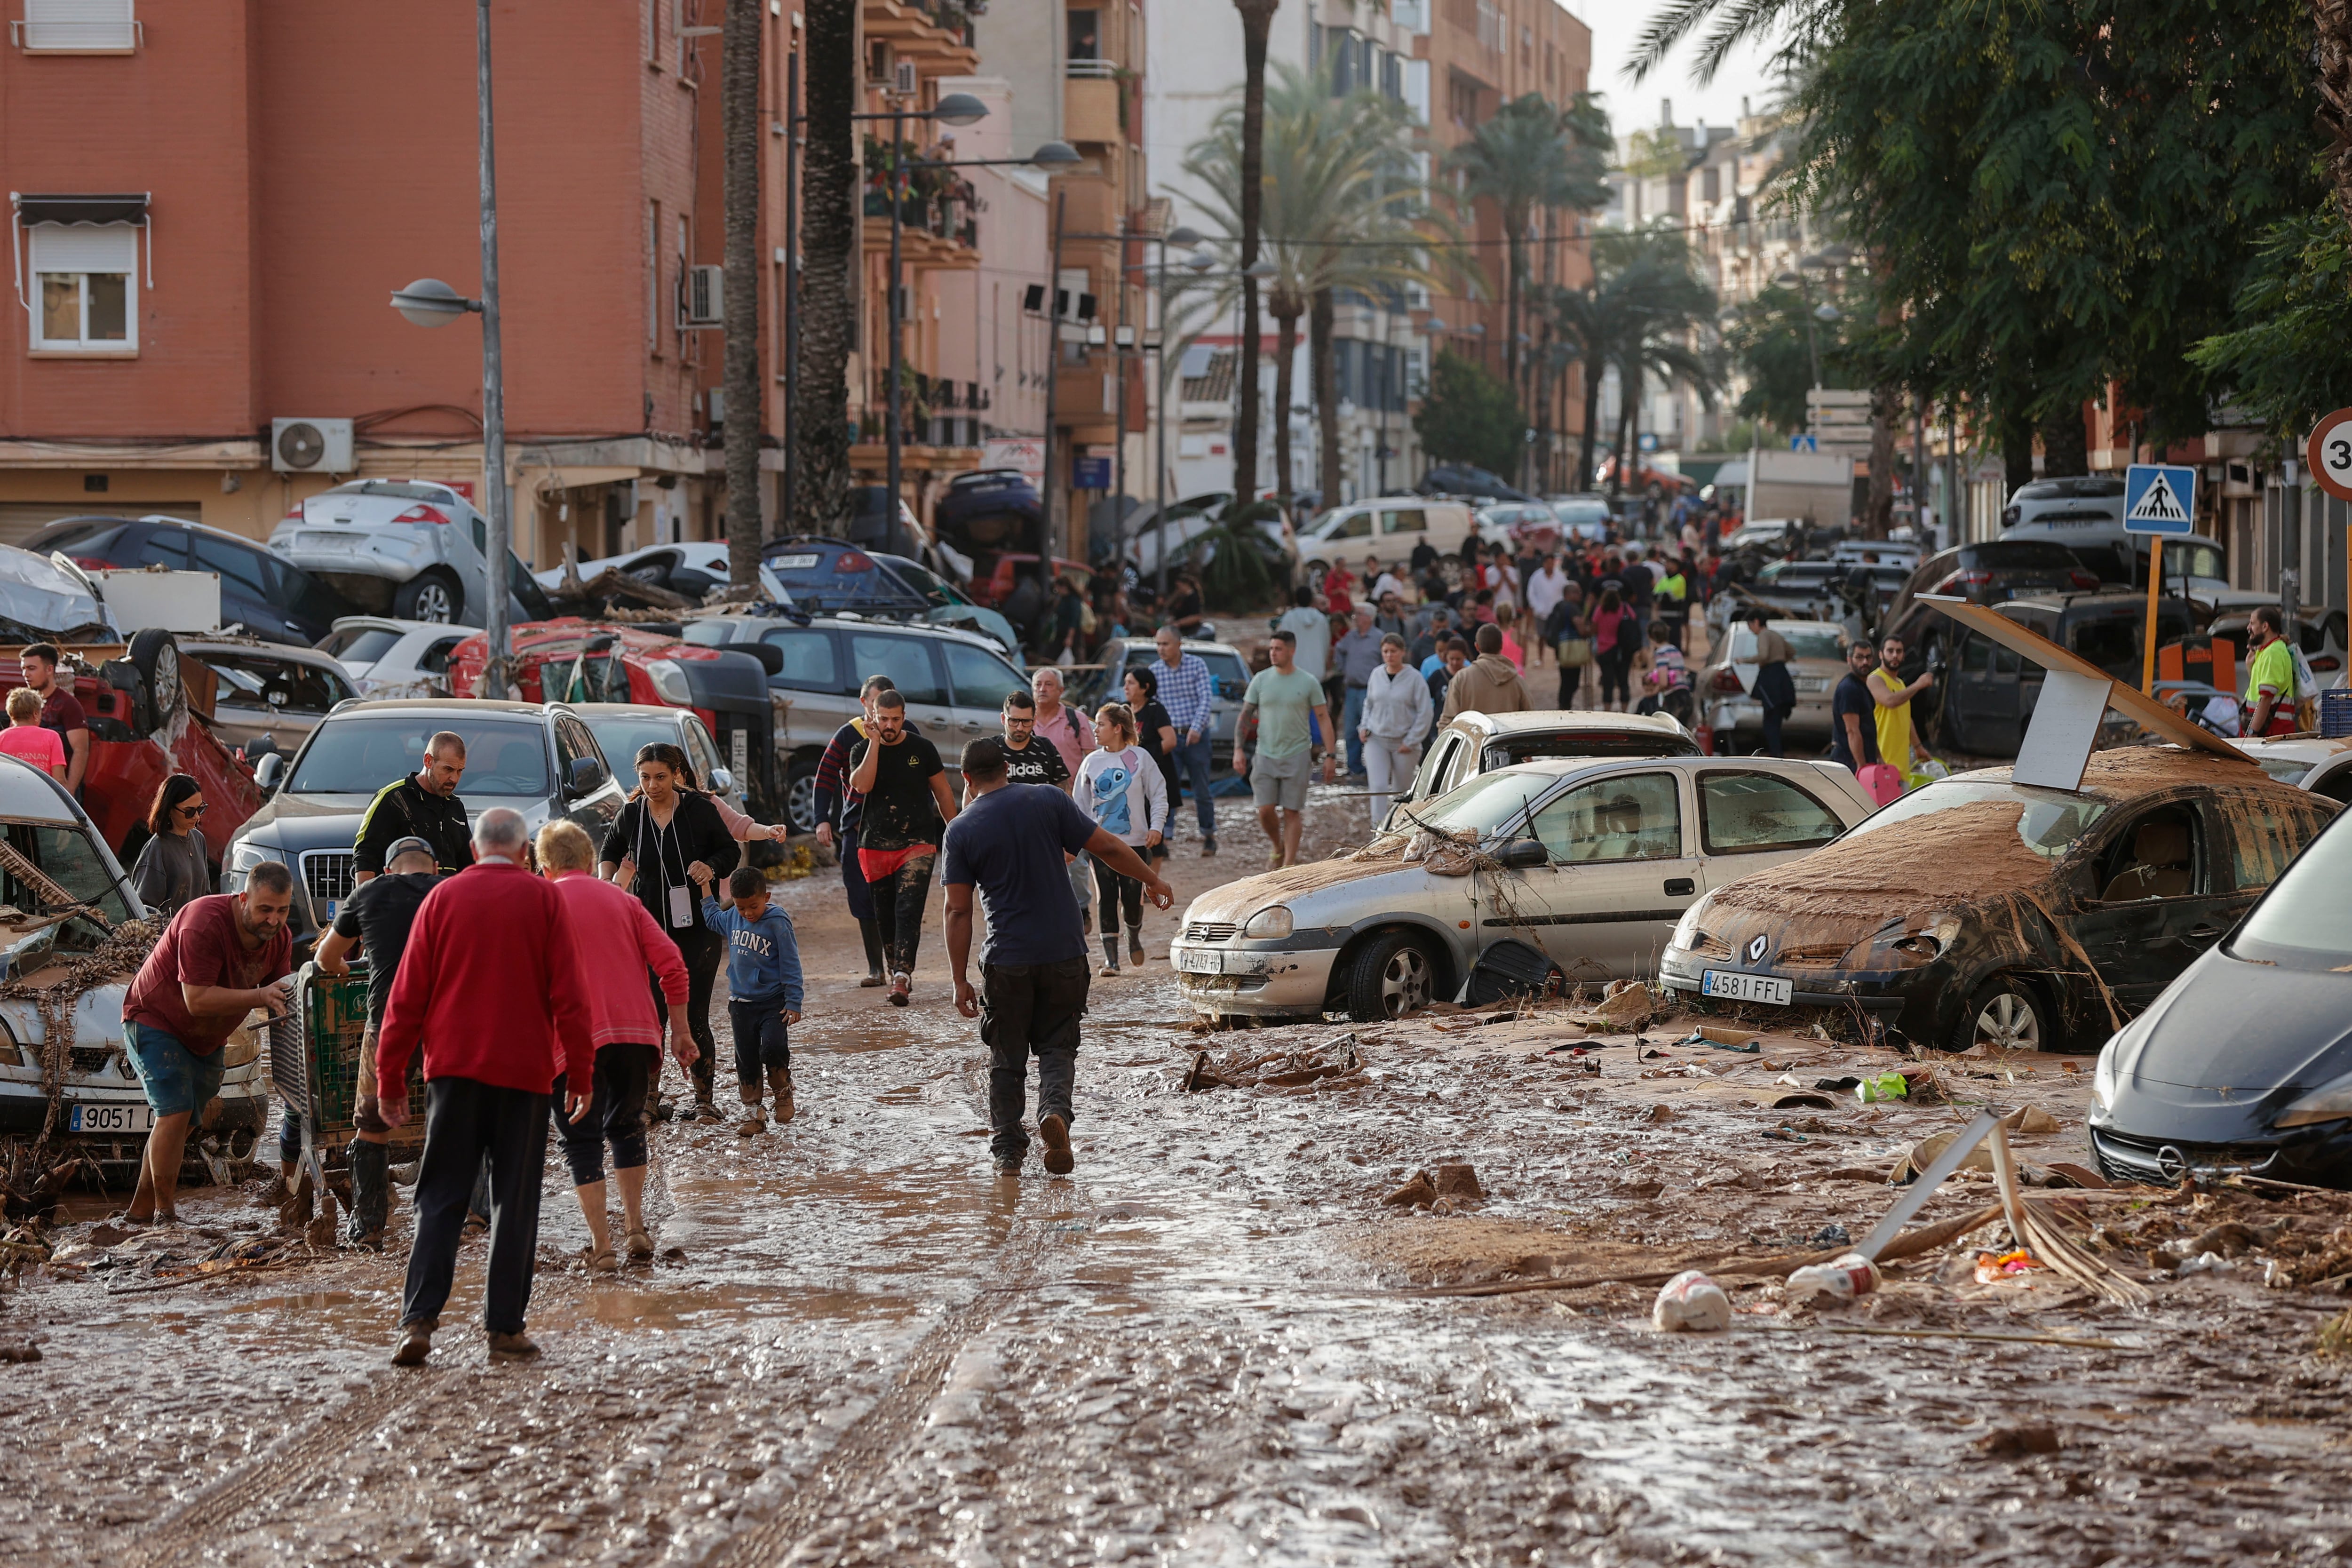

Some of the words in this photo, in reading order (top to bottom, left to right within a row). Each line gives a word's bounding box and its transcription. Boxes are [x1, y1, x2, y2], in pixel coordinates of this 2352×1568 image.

[2329, 440, 2352, 470] 3
[16, 752, 49, 761] GANAN
[1006, 762, 1043, 776] didas
[1712, 975, 1748, 996] 4581
[1754, 980, 1784, 1002] FFL
[86, 1108, 133, 1129] 9051
